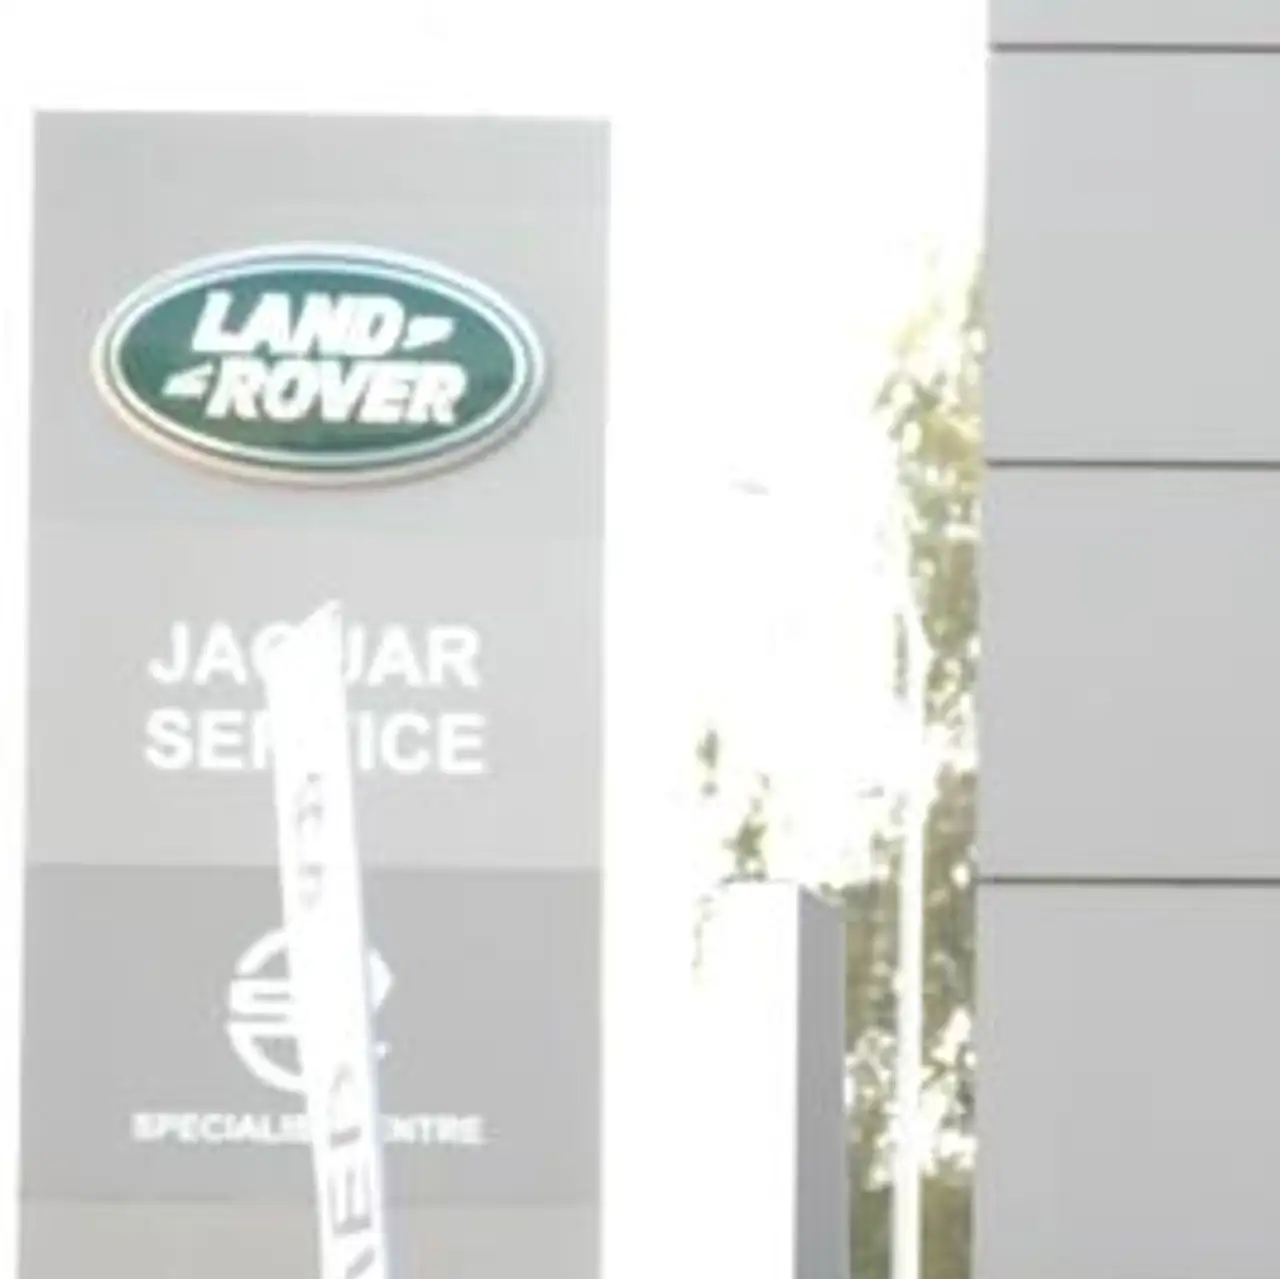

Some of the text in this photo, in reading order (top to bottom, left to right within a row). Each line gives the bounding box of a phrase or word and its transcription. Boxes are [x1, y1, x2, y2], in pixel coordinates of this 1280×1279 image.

[192, 290, 405, 357] LAND
[205, 357, 467, 424] ROVER
[145, 706, 487, 775] SEICE
[134, 1112, 309, 1147] SPECIALIS
